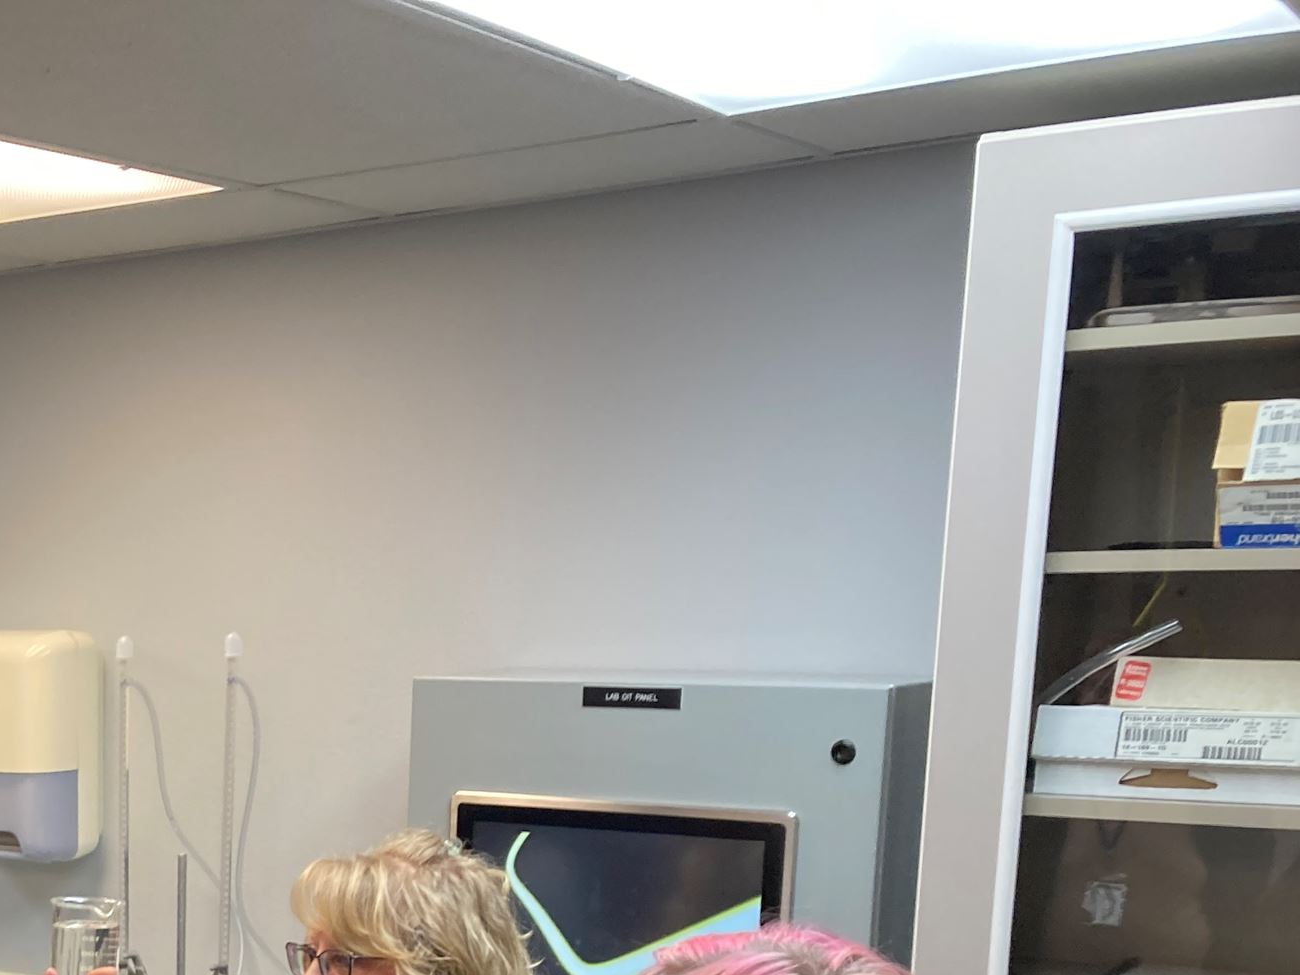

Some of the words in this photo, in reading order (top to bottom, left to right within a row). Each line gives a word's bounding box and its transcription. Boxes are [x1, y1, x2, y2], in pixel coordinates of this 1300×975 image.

[1236, 534, 1300, 545] herbrand
[605, 692, 620, 701] LAB
[635, 692, 658, 702] PANEL
